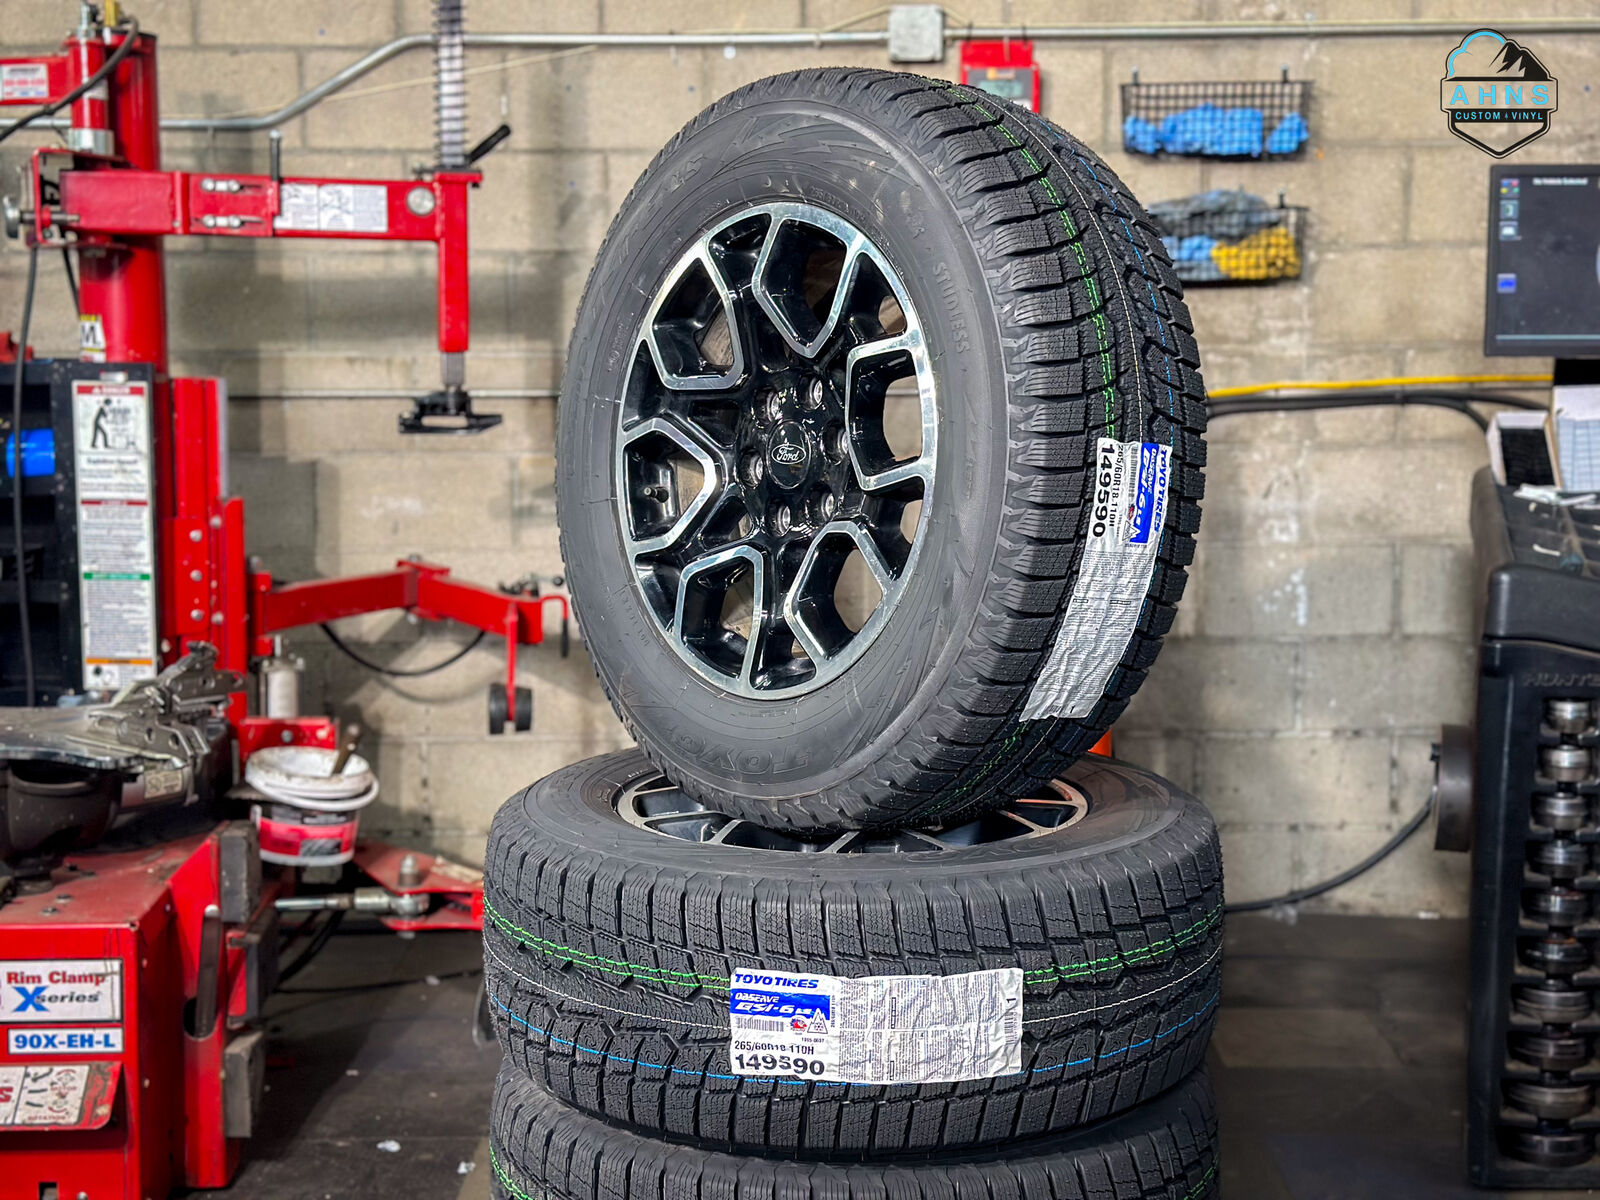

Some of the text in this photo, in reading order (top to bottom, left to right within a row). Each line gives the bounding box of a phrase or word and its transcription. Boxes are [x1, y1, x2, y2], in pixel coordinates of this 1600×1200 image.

[932, 261, 970, 353] STUDLESS
[776, 446, 800, 461] Ford
[1092, 444, 1115, 537] 149590
[6, 970, 106, 987] Rim Clamp
[14, 1033, 116, 1049] 90X-EH-L
[790, 1045, 814, 1055] 110H
[735, 1053, 825, 1075] 149590
